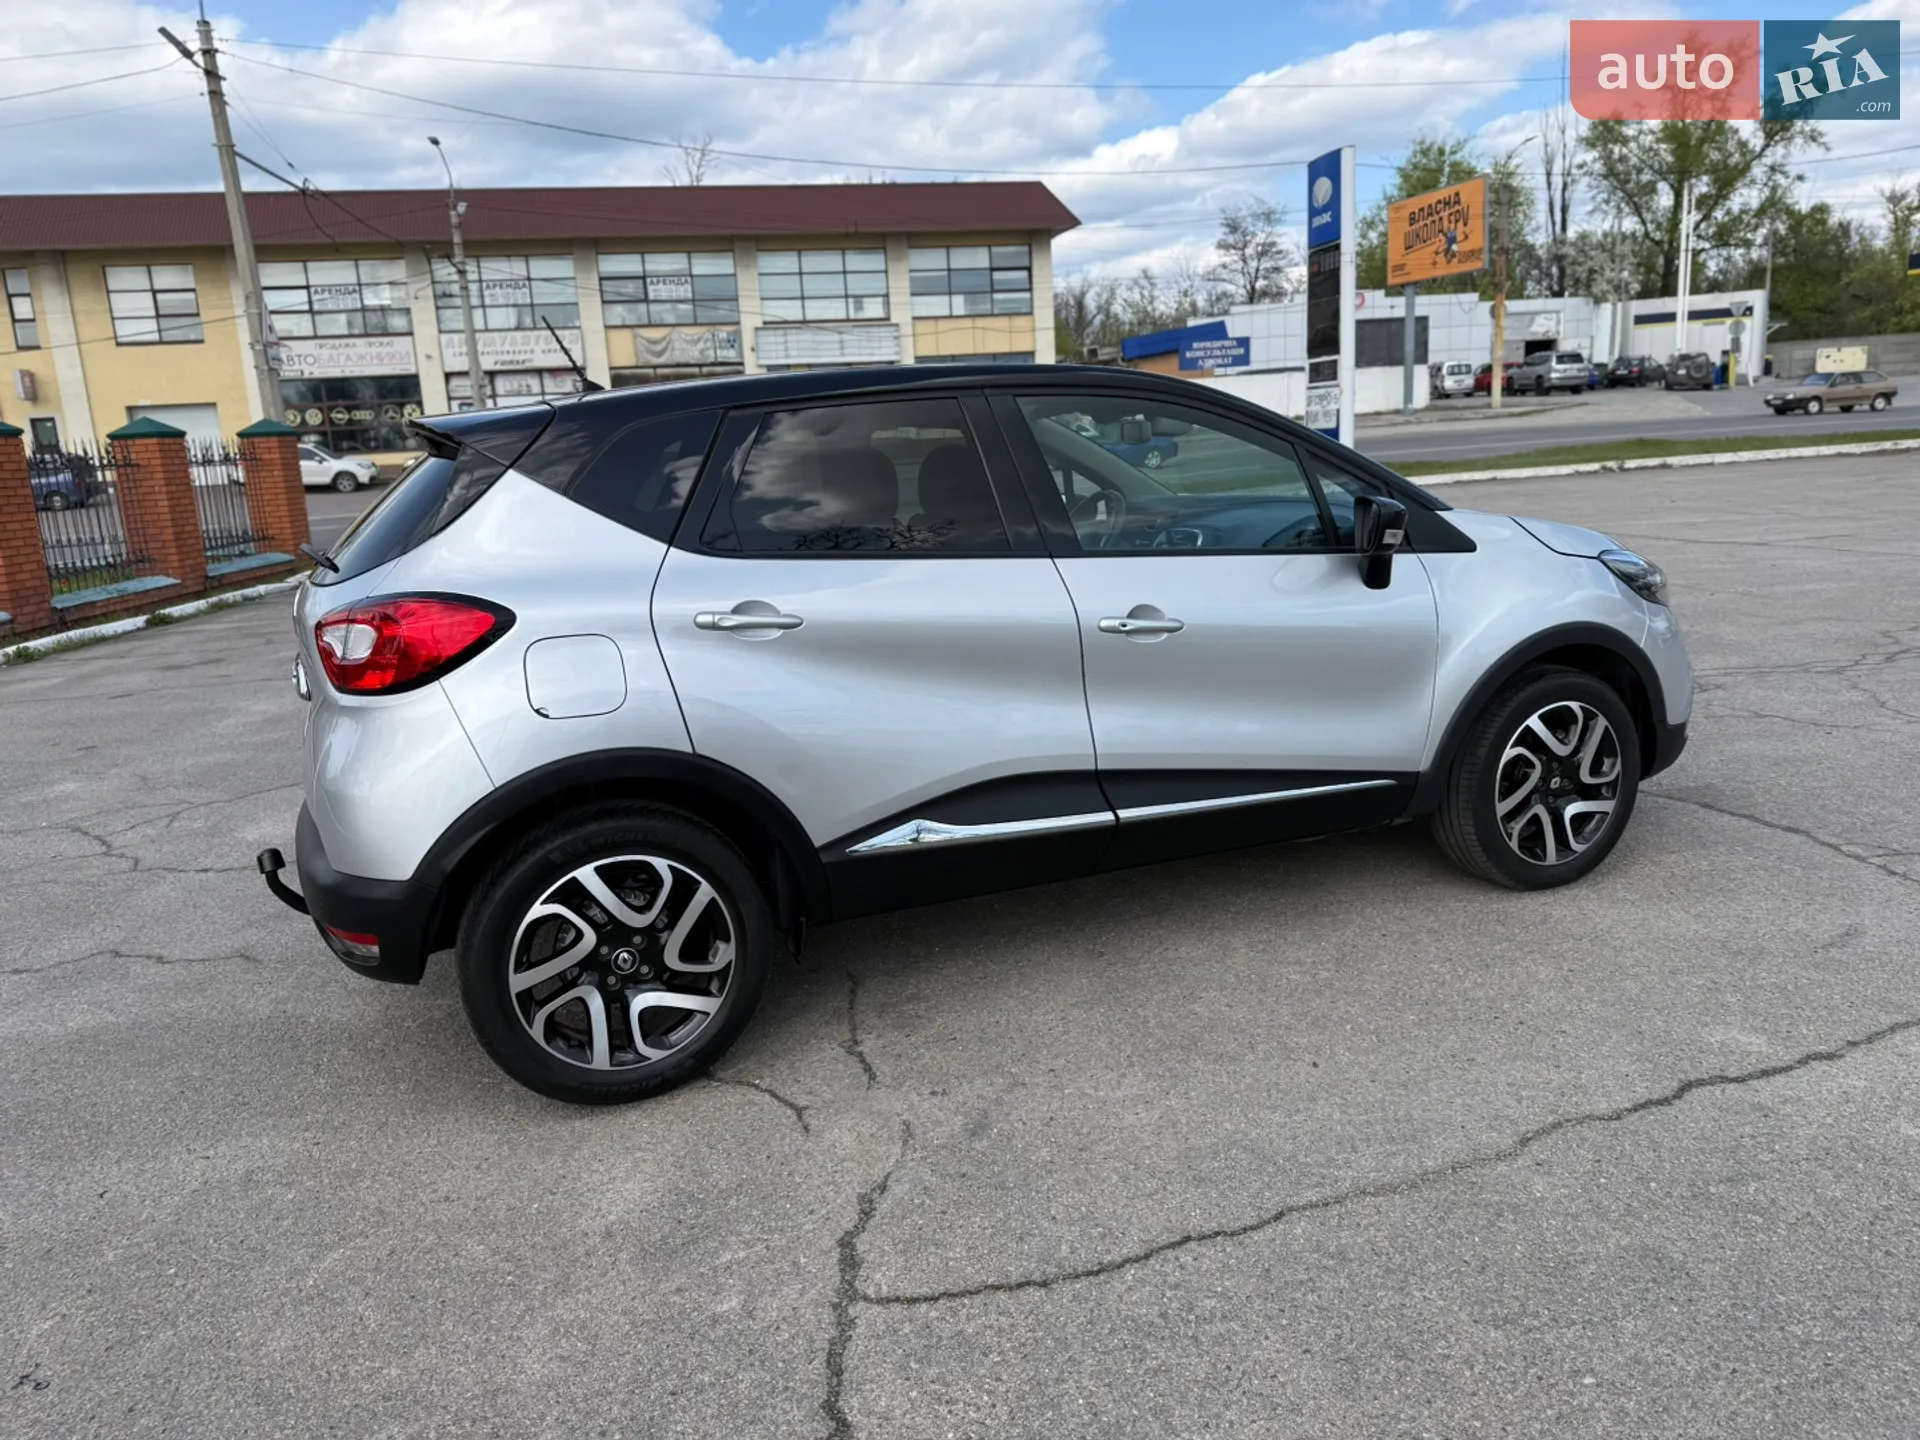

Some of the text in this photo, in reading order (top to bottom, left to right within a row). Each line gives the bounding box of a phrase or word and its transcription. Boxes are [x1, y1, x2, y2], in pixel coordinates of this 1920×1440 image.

[1408, 190, 1461, 227] ВЛАСНА
[1404, 216, 1445, 251] ШКОЛА
[485, 281, 528, 291] АРЕНДА
[649, 278, 690, 287] АРЕНДА
[313, 287, 359, 297] АРЕНДА
